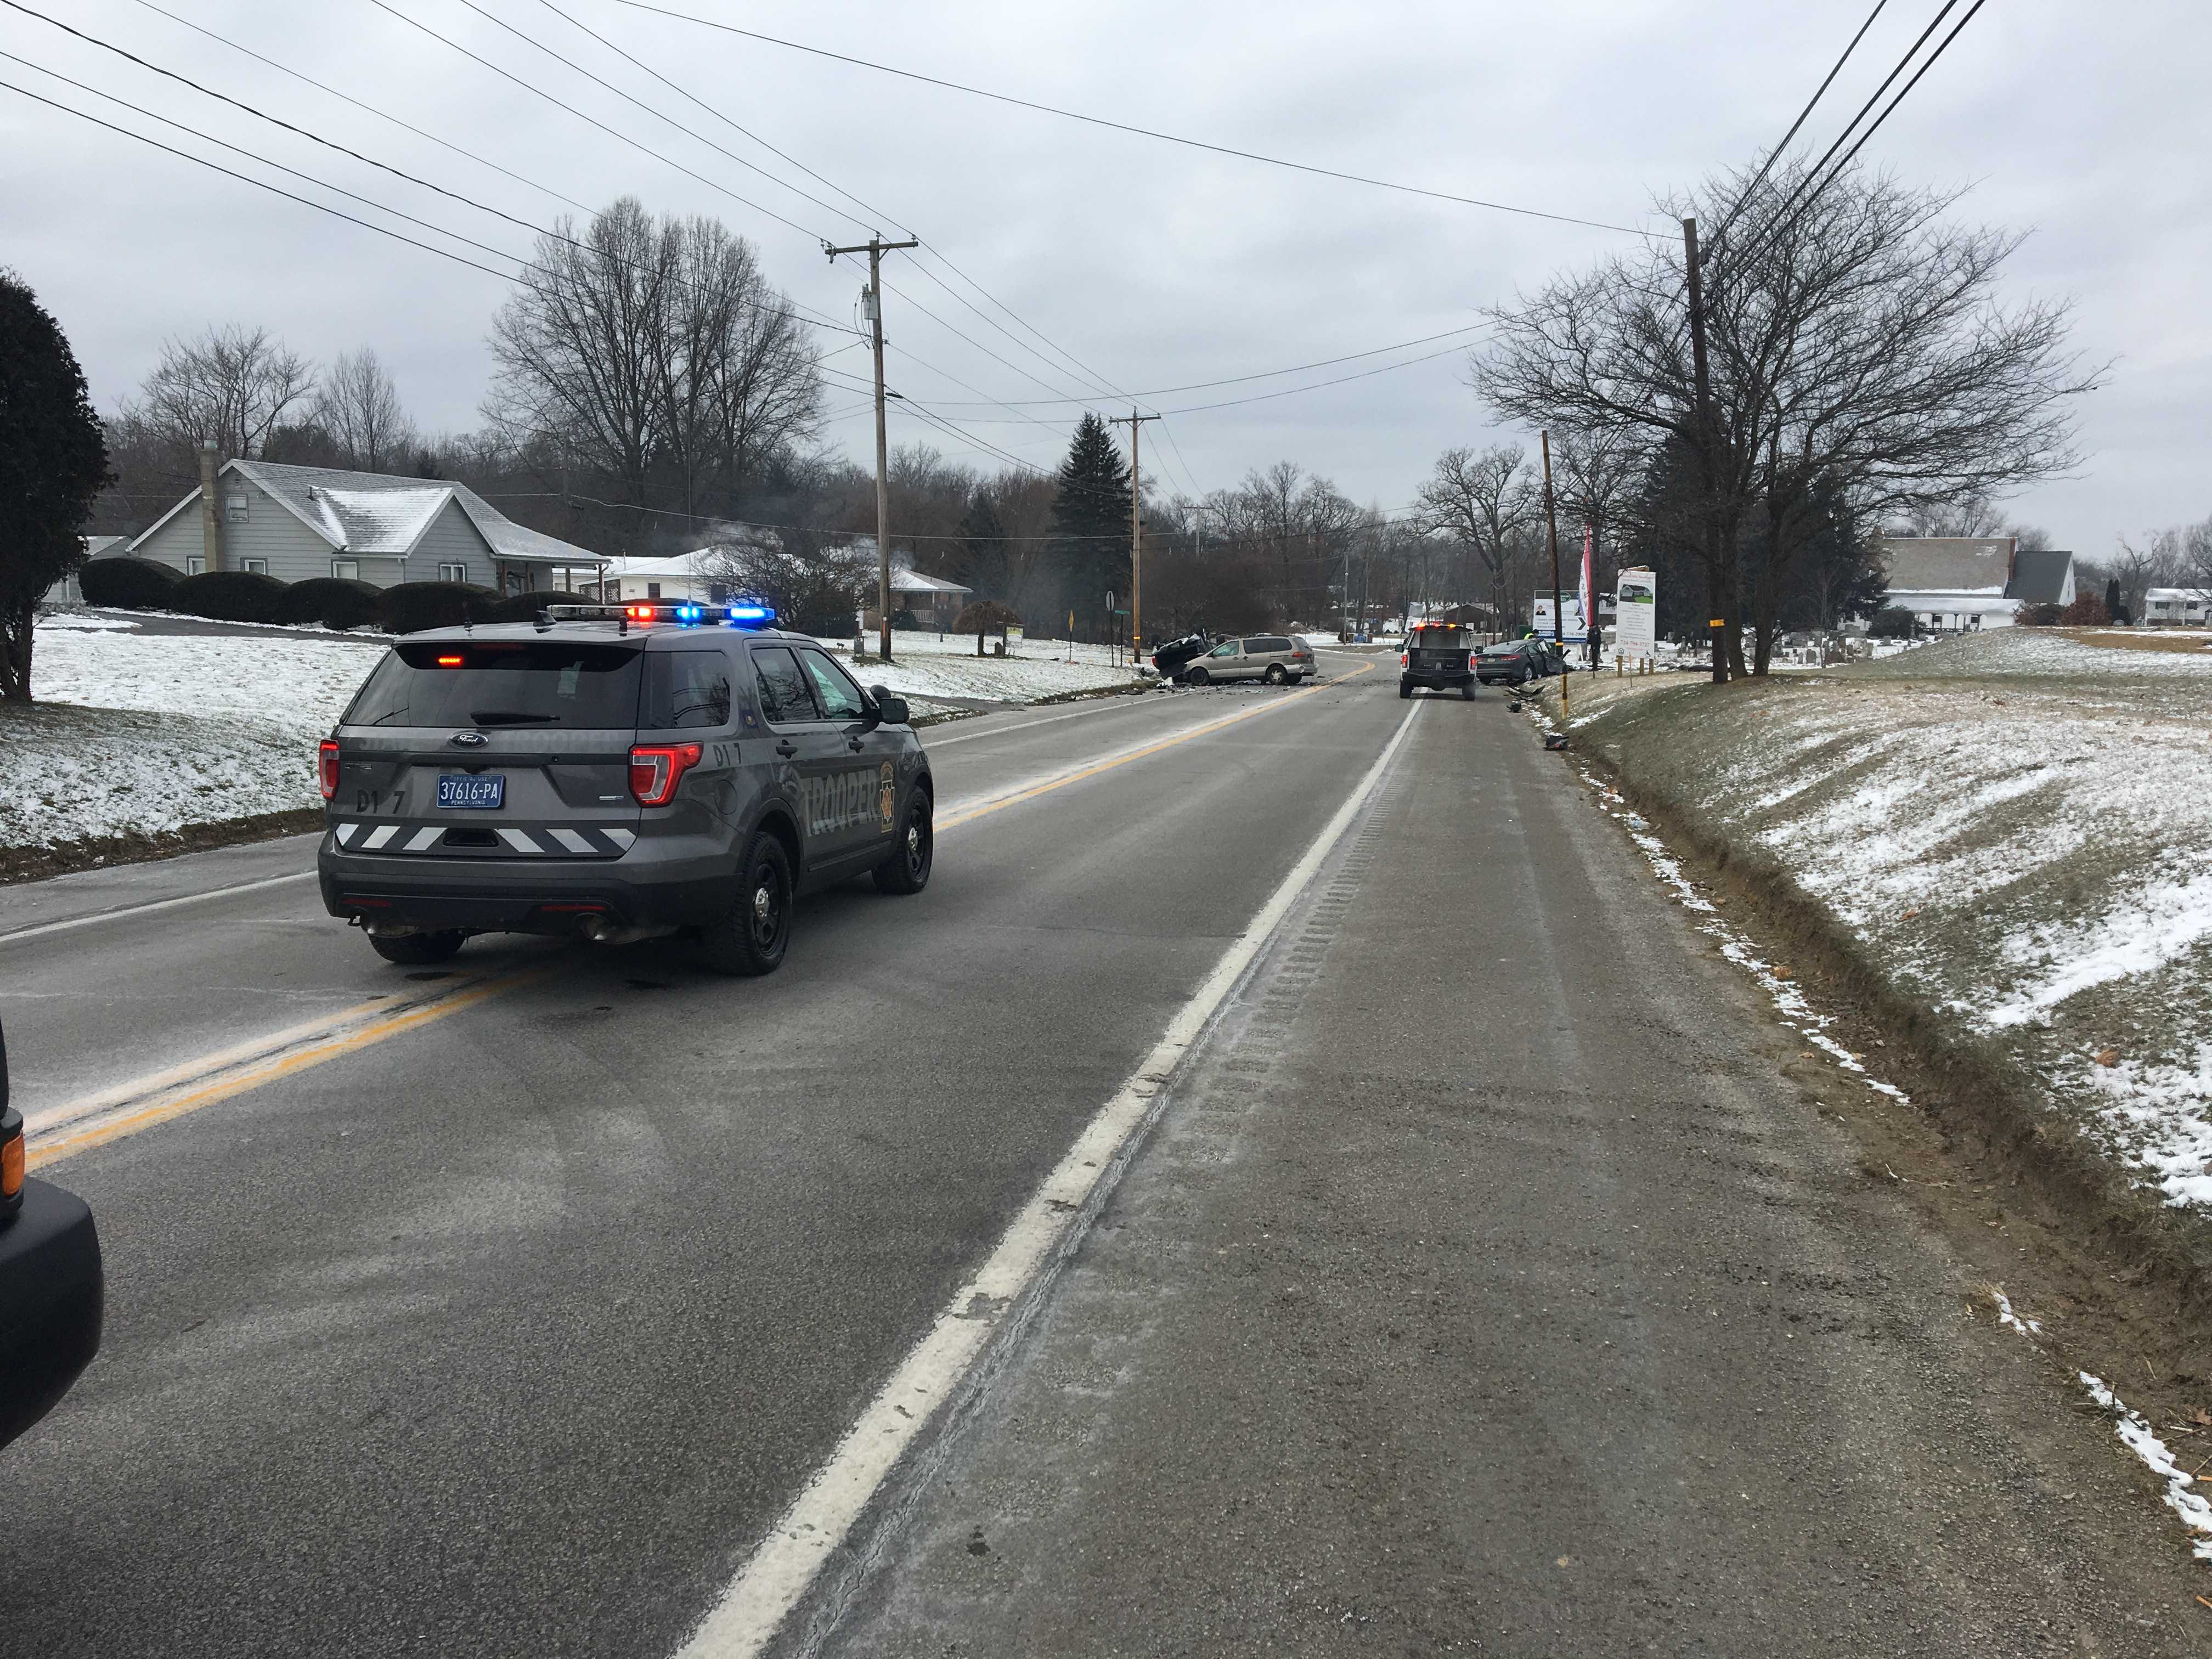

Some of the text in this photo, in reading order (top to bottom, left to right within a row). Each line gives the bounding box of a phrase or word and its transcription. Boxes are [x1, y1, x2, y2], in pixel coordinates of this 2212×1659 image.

[457, 735, 479, 743] Ford
[733, 743, 741, 764] 7
[441, 782, 498, 800] 37616-PA
[392, 791, 405, 814] 7
[799, 769, 879, 837] TROOPER
